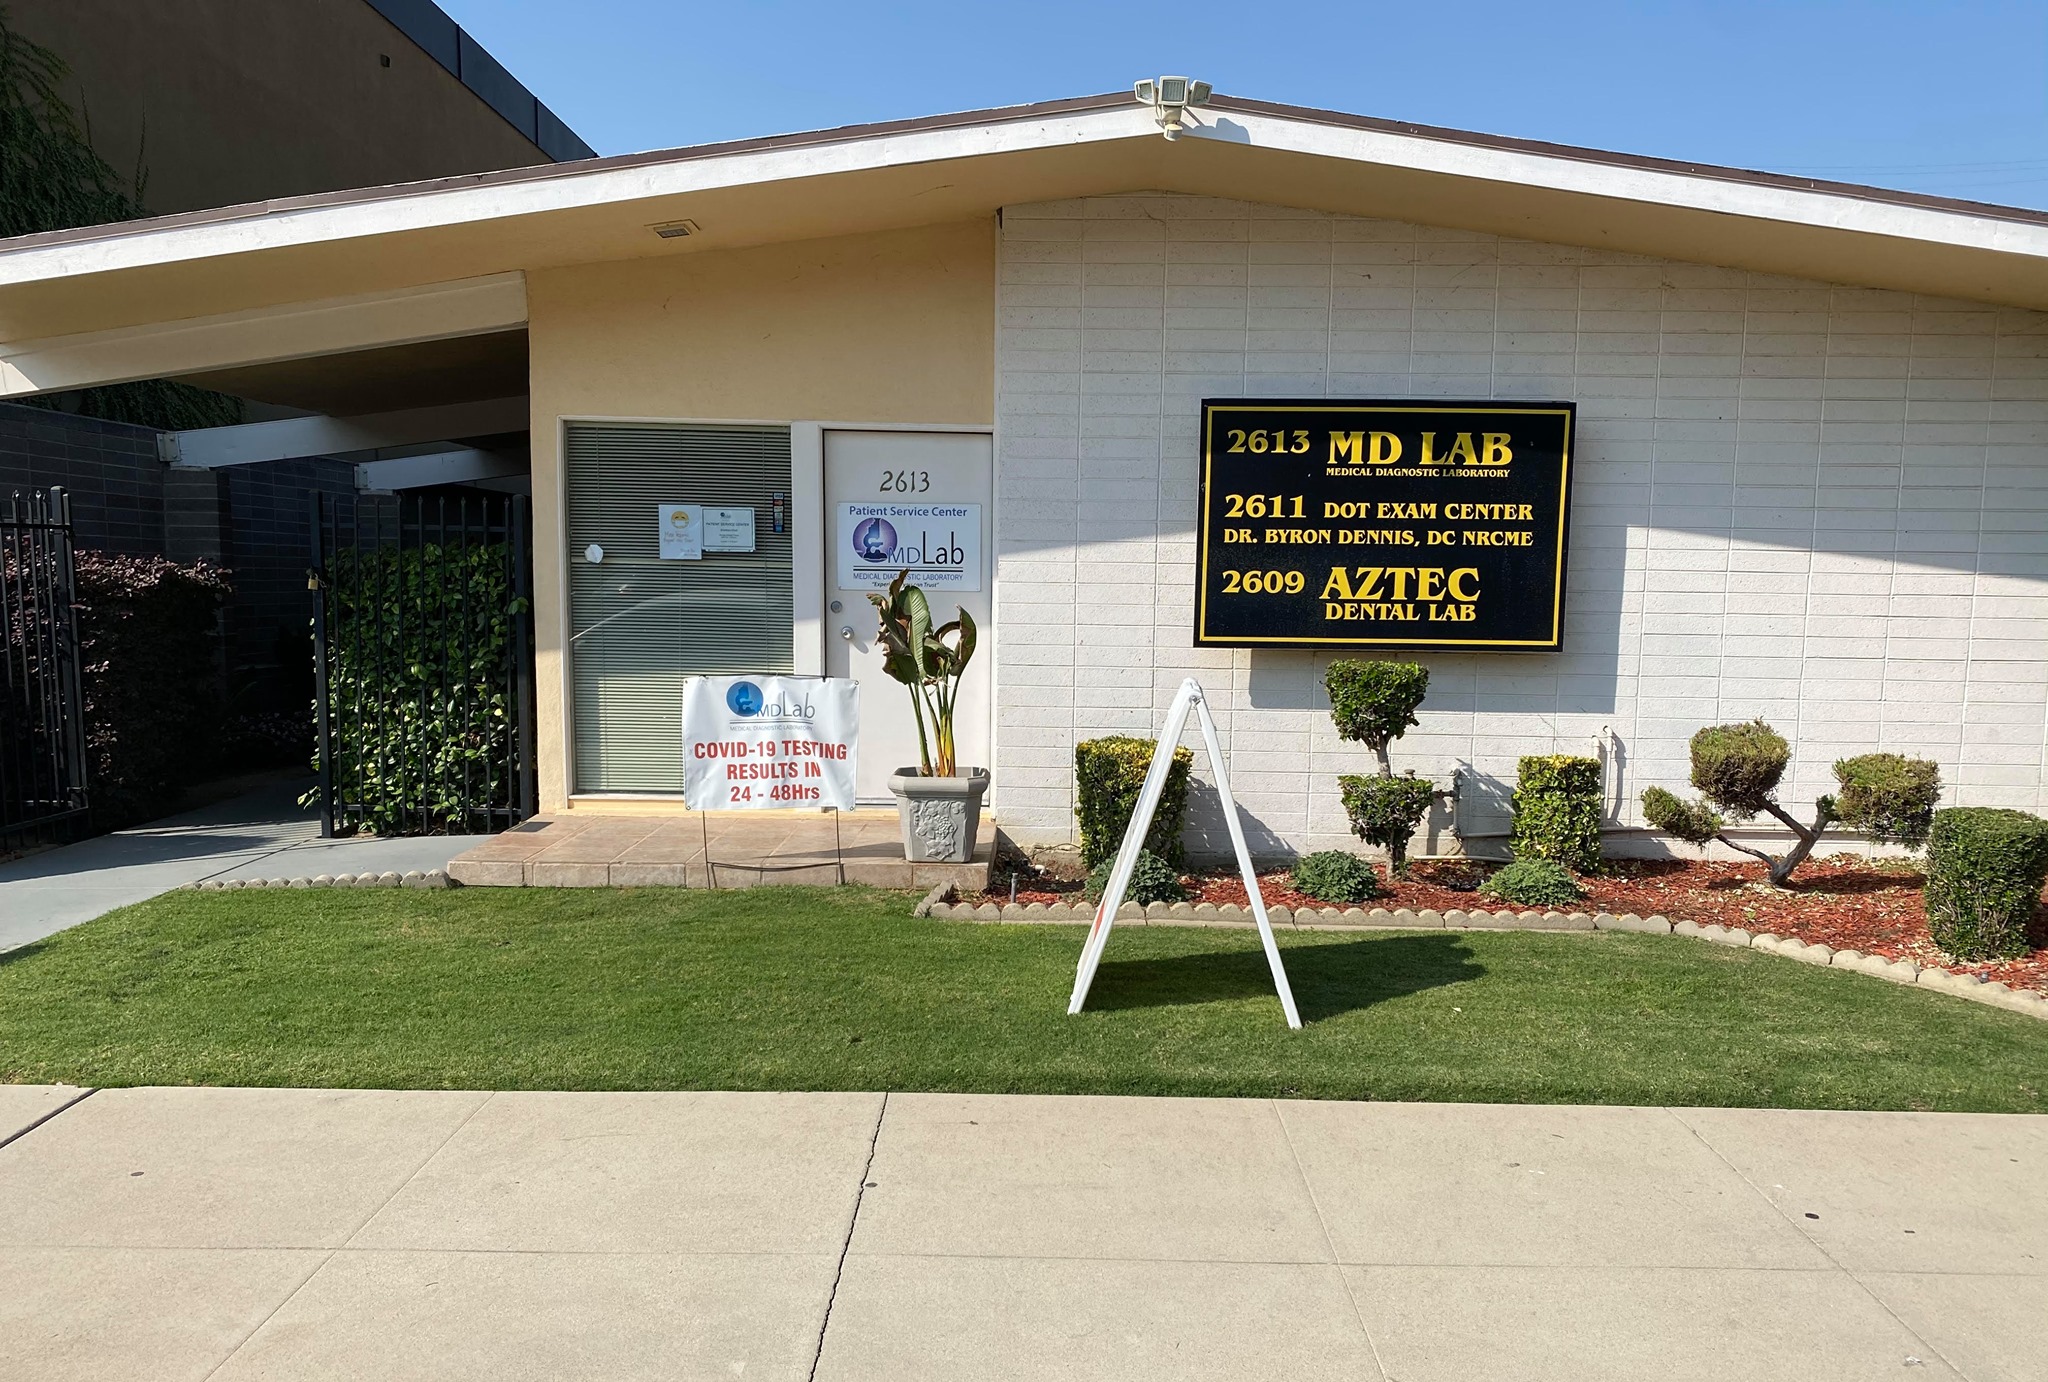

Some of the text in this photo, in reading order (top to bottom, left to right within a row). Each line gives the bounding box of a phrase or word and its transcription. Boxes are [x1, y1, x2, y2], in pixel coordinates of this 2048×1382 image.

[1227, 429, 1513, 467] 2613 MD LAB
[879, 470, 931, 494] 2613
[1325, 467, 1511, 478] MEDICAL DIAGNOSTIC LABORATORY
[849, 505, 968, 517] Patient Service Center
[1224, 494, 1534, 521] 2611 DOT EXAM CENTER
[1223, 529, 1534, 548] DR. BYRON DENNIS, DC NRCME
[853, 572, 963, 582] MEDICAL DIAGSTIC LABORATORY
[1222, 566, 1482, 602] 2609 AZTEC
[1325, 603, 1477, 622] DENTAL LAB
[729, 724, 752, 732] MEDICAL
[782, 724, 814, 732] LABORATORY
[694, 740, 848, 760] COVID-19 TESTING
[726, 762, 822, 780] RESULTS IN
[730, 785, 752, 803] 24
[769, 783, 821, 801] 48Hrs
